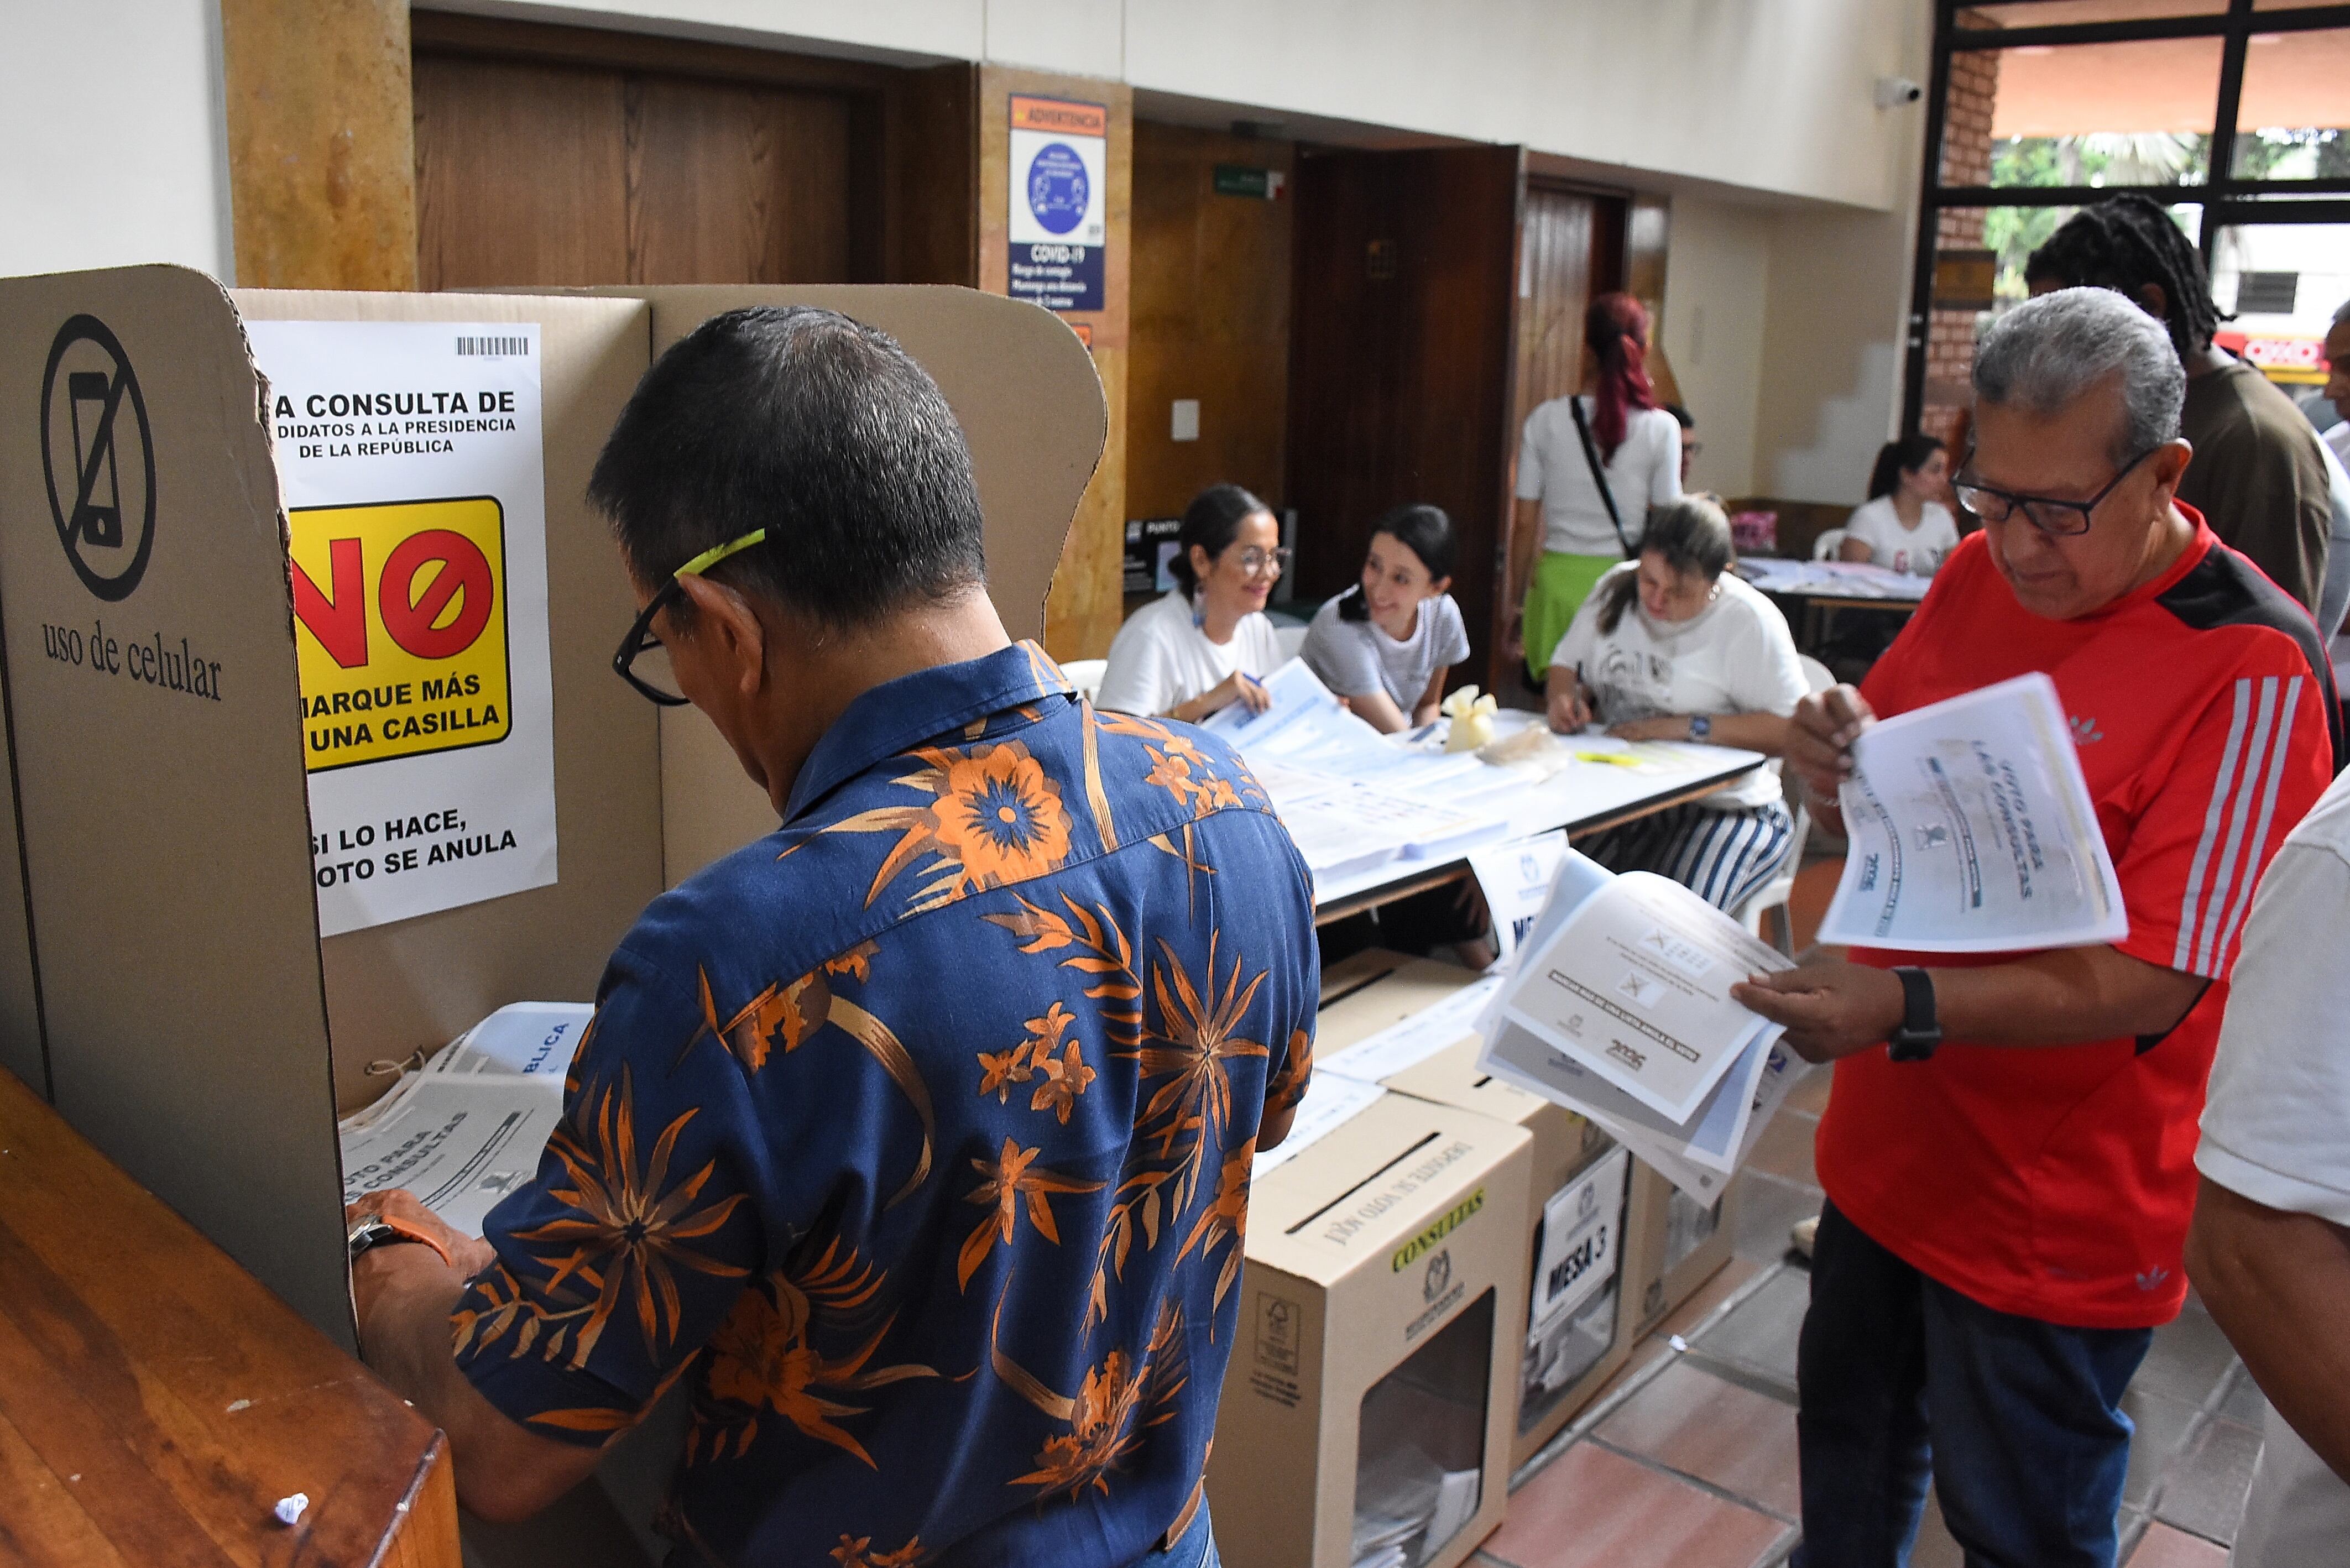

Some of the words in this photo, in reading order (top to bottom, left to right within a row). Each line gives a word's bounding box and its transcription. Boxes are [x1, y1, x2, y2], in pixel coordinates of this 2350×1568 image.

[275, 395, 295, 419] A
[306, 392, 468, 417] CONSULTA
[479, 391, 515, 412] DE
[278, 423, 355, 438] DIDATOS
[361, 423, 372, 436] A
[378, 422, 399, 435] LA
[405, 418, 516, 433] PRESIDENCIA
[300, 445, 323, 458] DE
[330, 443, 351, 457] LA
[358, 438, 453, 456] REPÚBLICA
[43, 623, 83, 665] uso
[91, 619, 121, 675] de
[128, 631, 221, 701] celular
[422, 671, 481, 702] MÁS
[311, 723, 374, 751] UNA
[383, 704, 500, 740] CASILLA
[340, 825, 375, 850] LO
[385, 809, 466, 842] HACE,
[317, 859, 374, 887] OTO
[385, 849, 419, 874] SE
[427, 830, 517, 866] ANULA
[522, 1022, 570, 1074] BLICA
[363, 1111, 468, 1189] CONSULTAS
[380, 1131, 431, 1163] PARA
[1547, 1236, 1592, 1303] MESA
